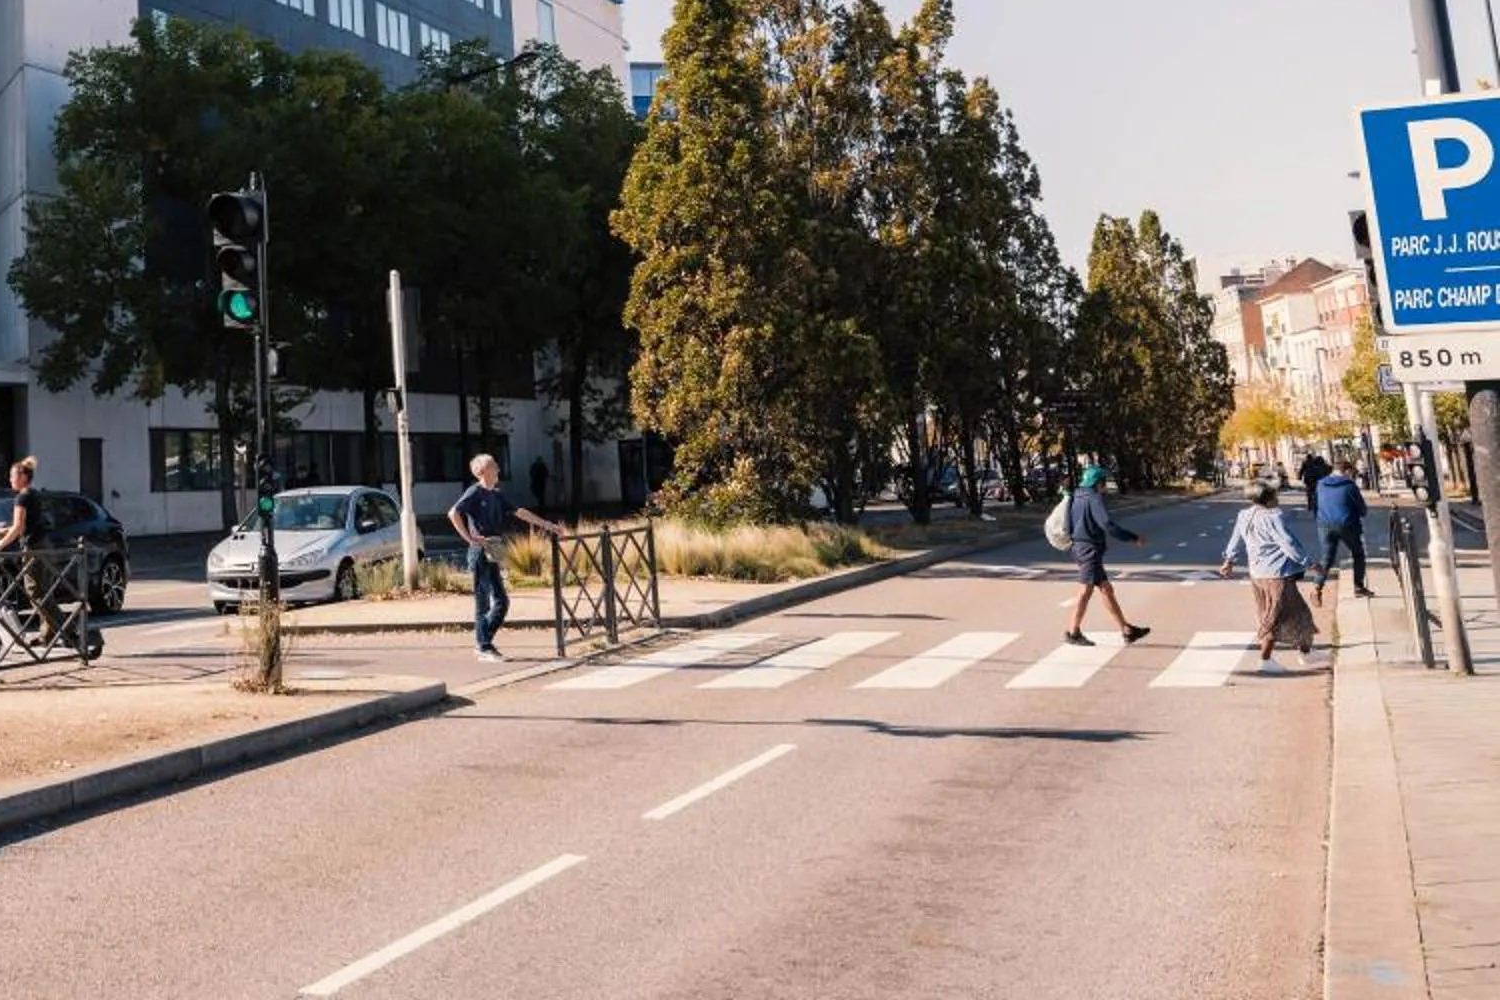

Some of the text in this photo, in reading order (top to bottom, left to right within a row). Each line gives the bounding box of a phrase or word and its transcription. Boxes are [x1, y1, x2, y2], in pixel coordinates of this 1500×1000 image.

[1406, 117, 1494, 220] P
[1391, 235, 1430, 257] PARC
[1433, 233, 1463, 255] J.J.
[1395, 288, 1433, 310] PARC
[1437, 284, 1491, 308] CHAMP
[1400, 348, 1482, 368] 850 m
